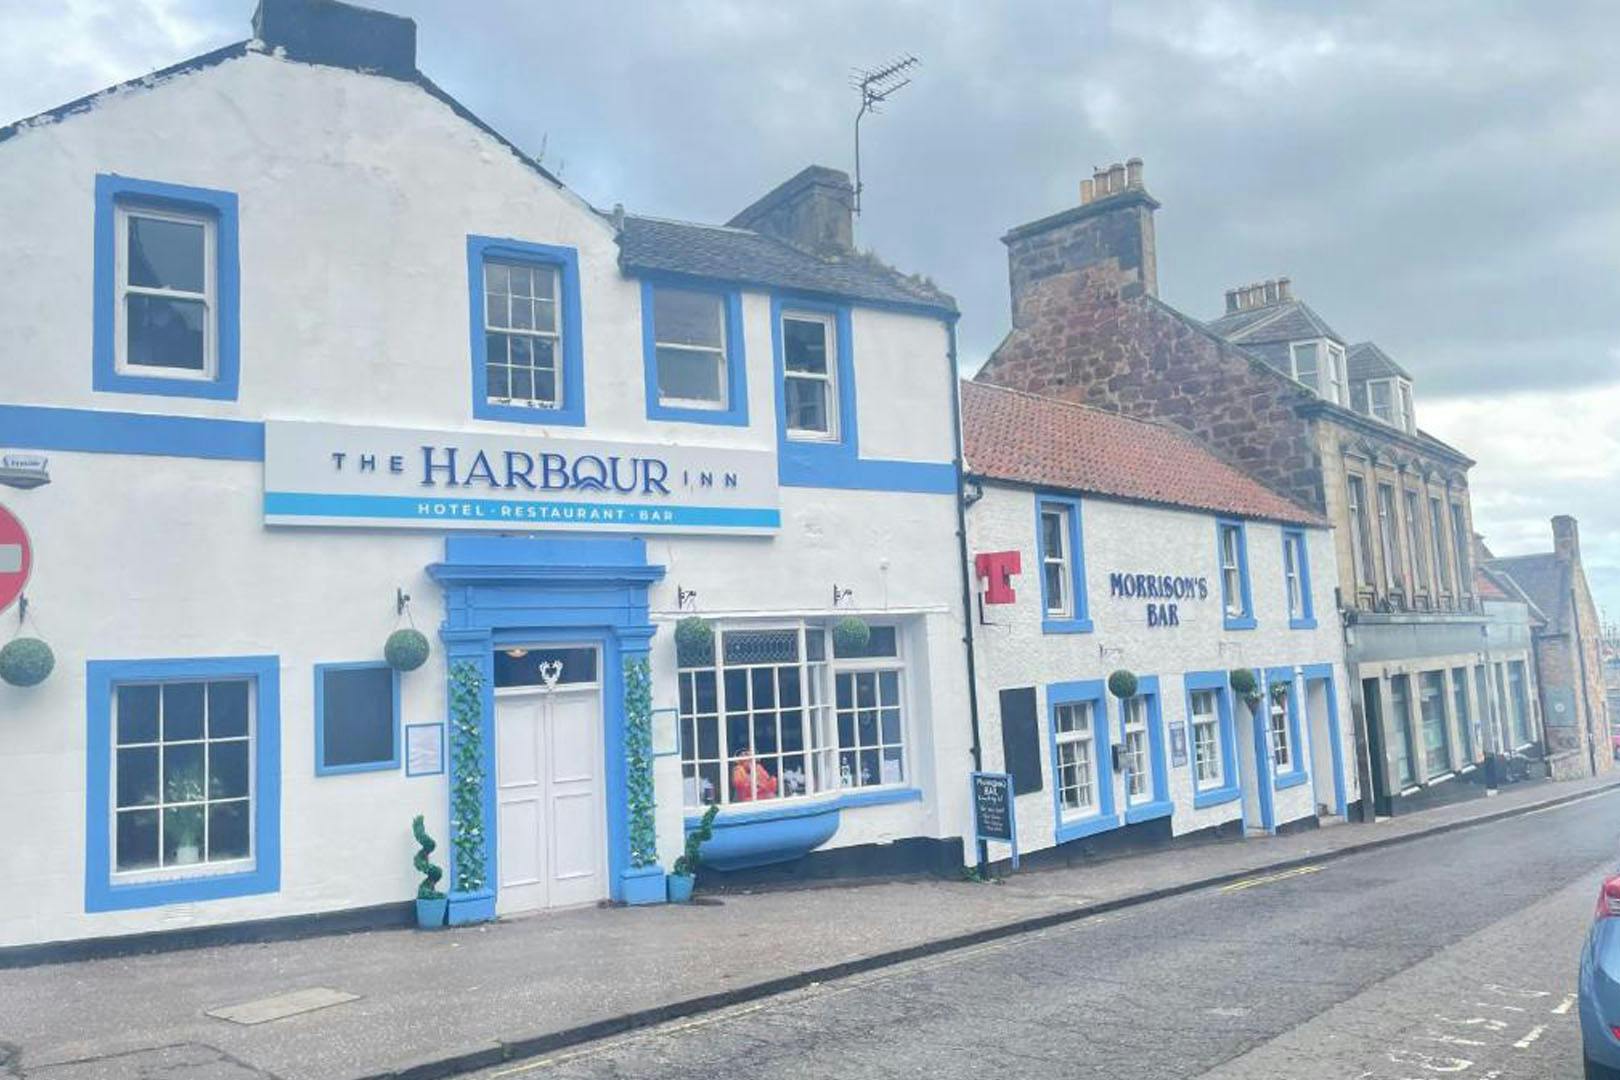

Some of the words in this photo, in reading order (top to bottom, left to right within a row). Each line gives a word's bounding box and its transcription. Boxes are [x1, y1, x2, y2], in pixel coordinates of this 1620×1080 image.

[331, 452, 404, 473] THE
[420, 445, 671, 496] HARBOUR
[683, 470, 739, 489] INN
[418, 503, 485, 517] HOTEL
[501, 505, 625, 520] RESTAURANT
[639, 509, 675, 522] BAR
[1110, 572, 1208, 600] MORRISON'S
[1148, 603, 1180, 627] BAR
